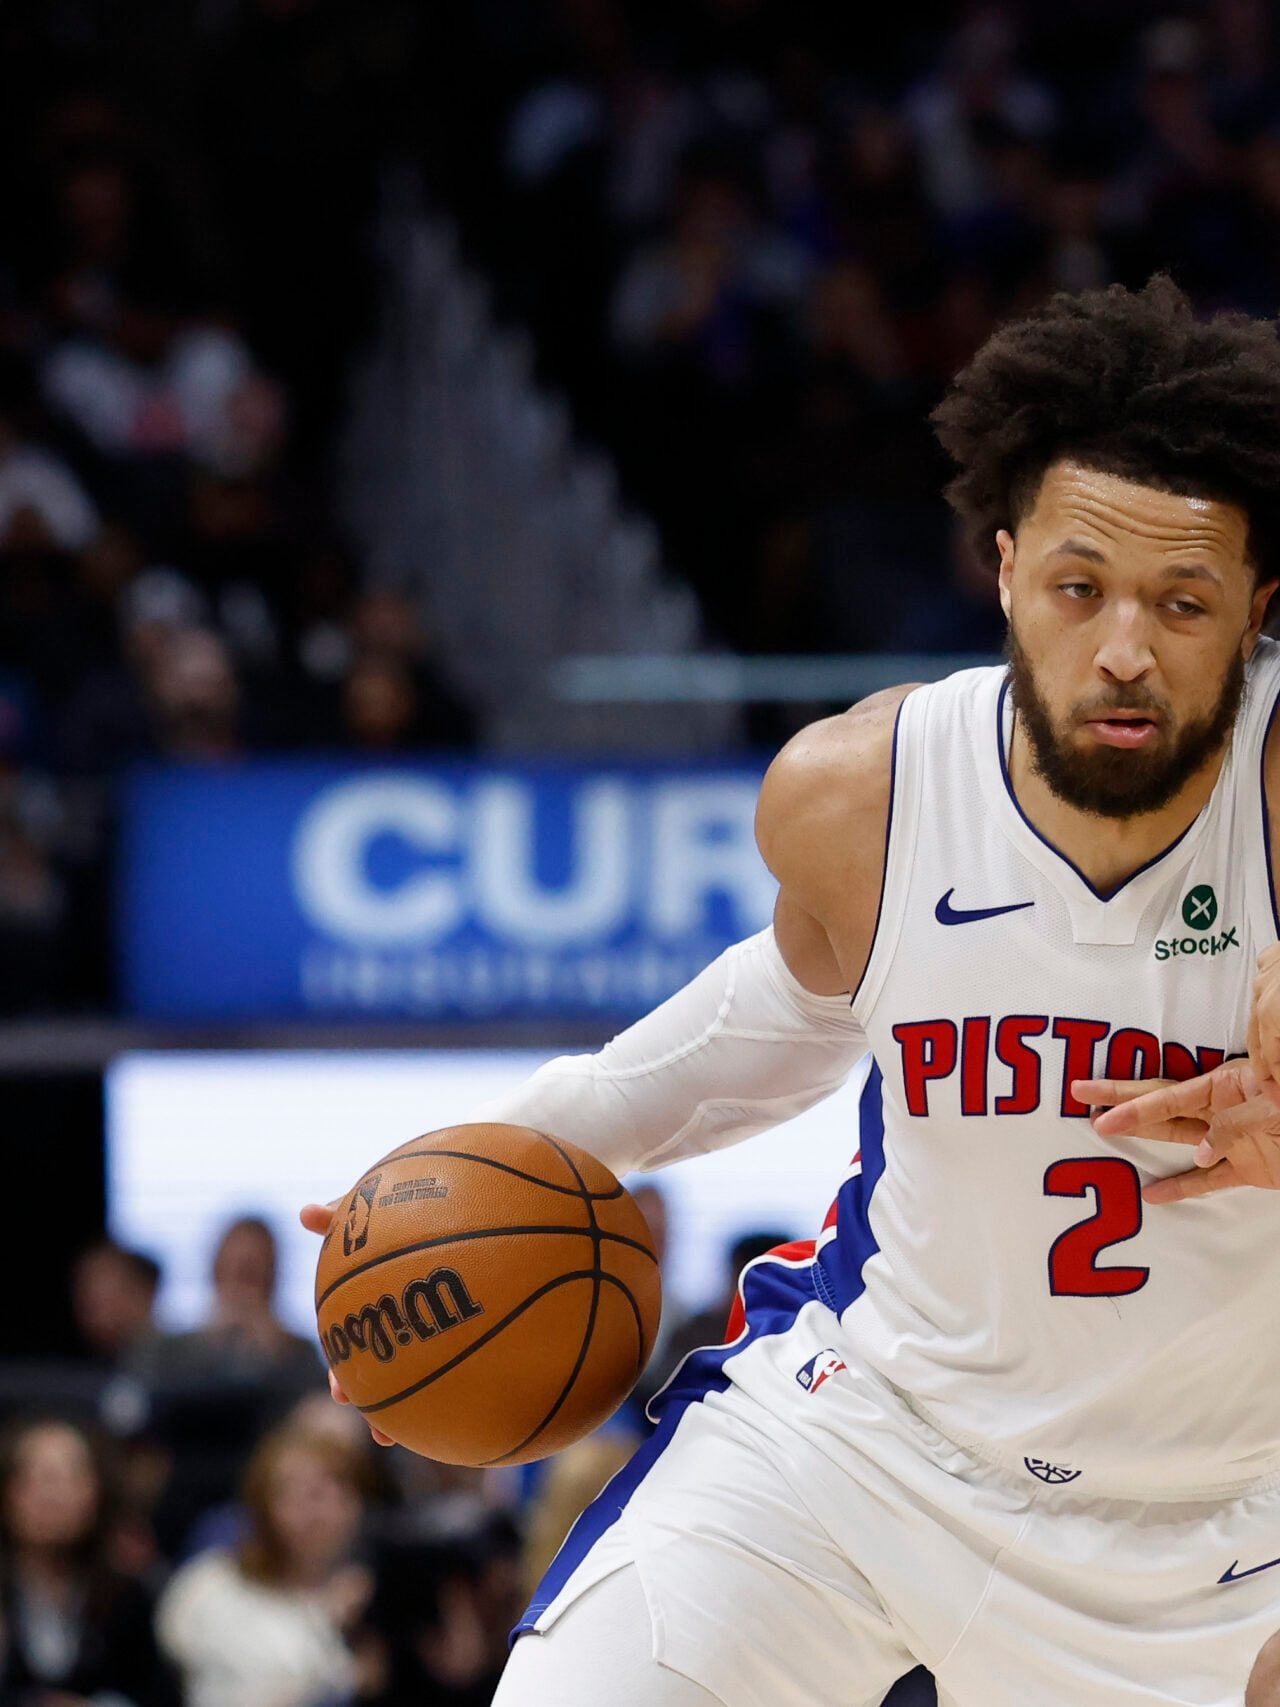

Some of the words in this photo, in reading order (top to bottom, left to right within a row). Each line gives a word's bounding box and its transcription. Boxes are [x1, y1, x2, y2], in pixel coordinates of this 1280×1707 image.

[1154, 926, 1240, 961] StockX
[891, 1014, 1250, 1118] PISTO
[1043, 1156, 1150, 1297] 2
